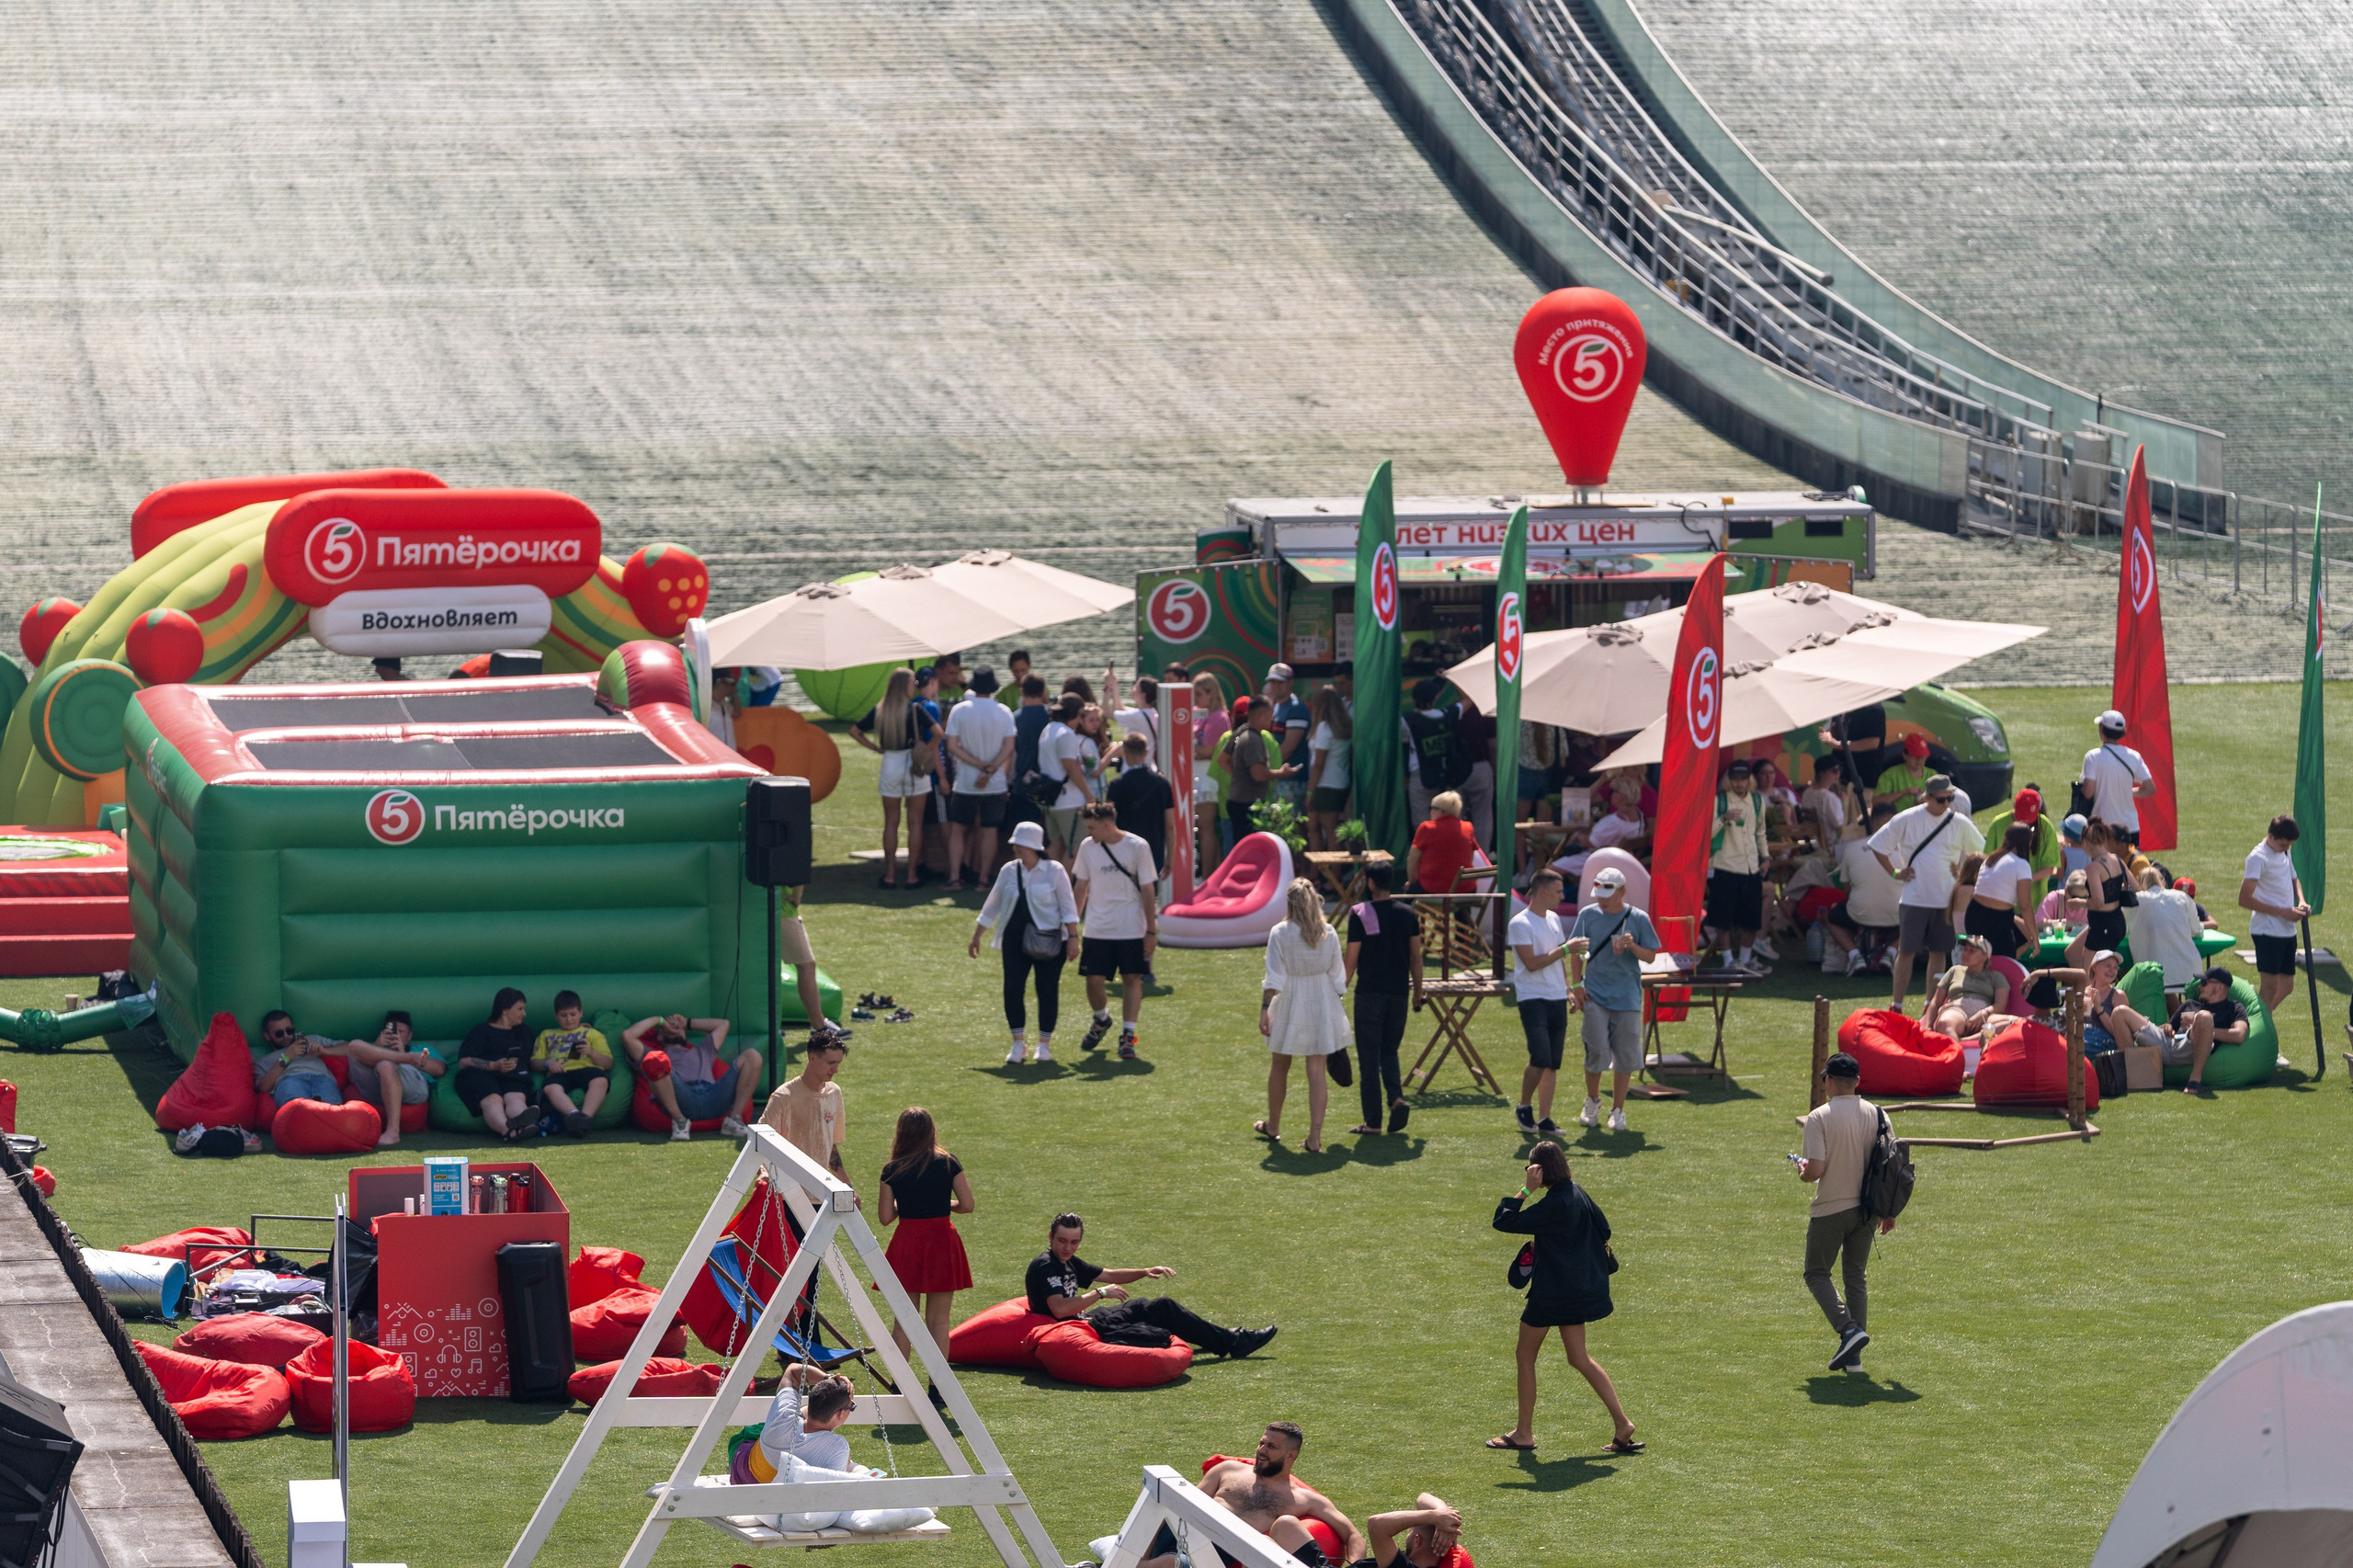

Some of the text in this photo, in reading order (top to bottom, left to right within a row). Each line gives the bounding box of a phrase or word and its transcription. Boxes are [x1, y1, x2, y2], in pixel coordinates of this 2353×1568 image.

[1538, 319, 1634, 366] Место притяжения
[1395, 523, 1635, 545] лет низих цен
[377, 534, 581, 570] Пятёрочка
[362, 608, 517, 631] Вдохновляет
[435, 803, 624, 835] Пятёрочка
